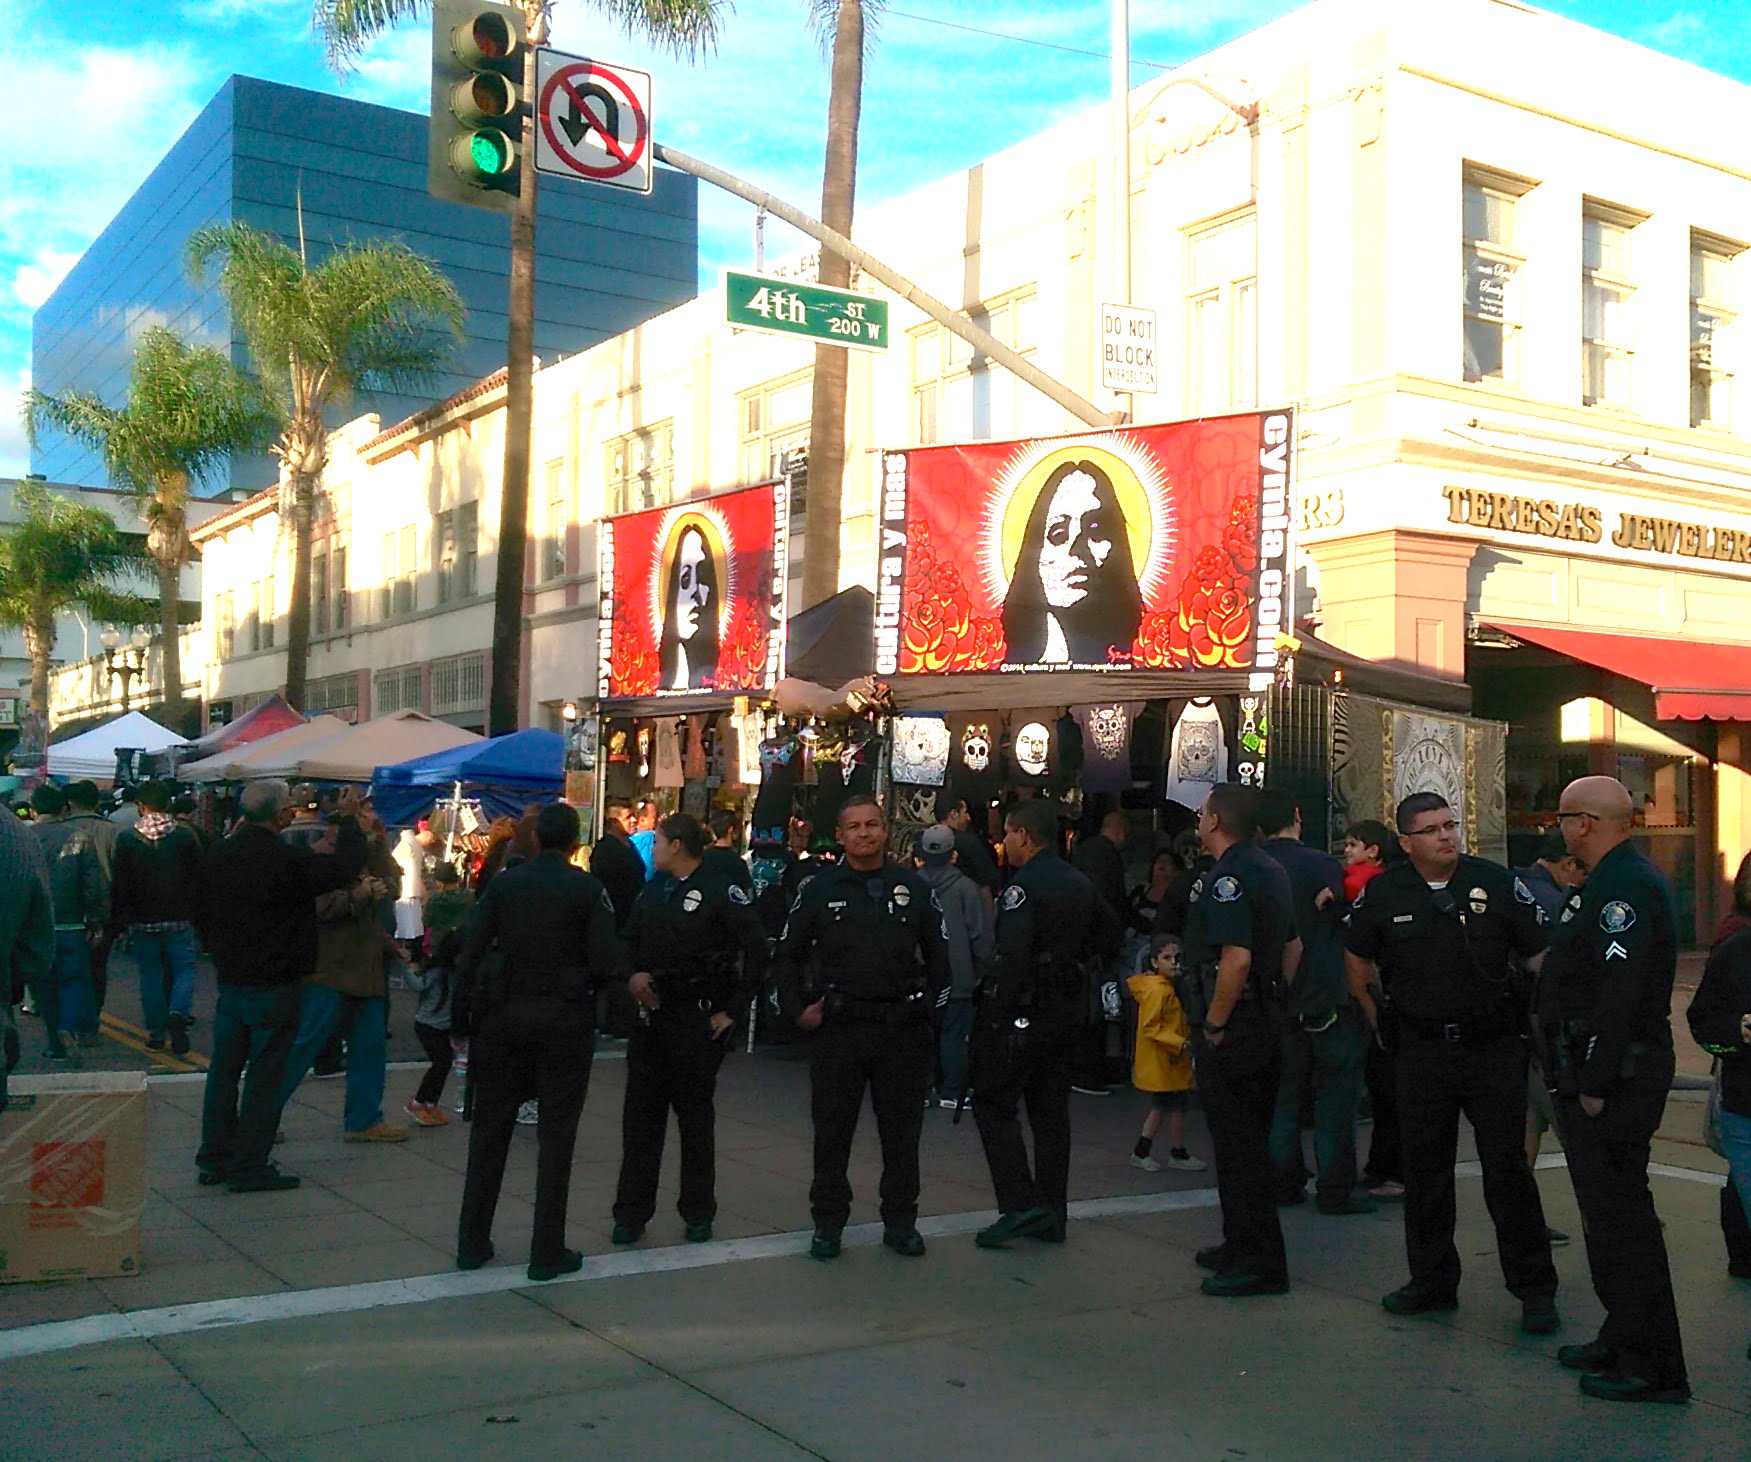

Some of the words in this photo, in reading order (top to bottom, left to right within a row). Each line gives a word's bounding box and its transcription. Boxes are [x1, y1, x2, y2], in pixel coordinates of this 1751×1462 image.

[745, 287, 808, 325] 4th
[845, 302, 867, 320] ST
[828, 317, 861, 337] 200
[865, 322, 882, 339] W
[1105, 315, 1122, 335] DO
[1129, 319, 1153, 339] NOT
[1105, 343, 1154, 367] BLOCK
[1301, 489, 1345, 530] RS
[1442, 485, 1602, 543] TERESA'S
[1612, 512, 1751, 563] JEWELER
[883, 528, 907, 550] y
[875, 556, 903, 675] cultura
